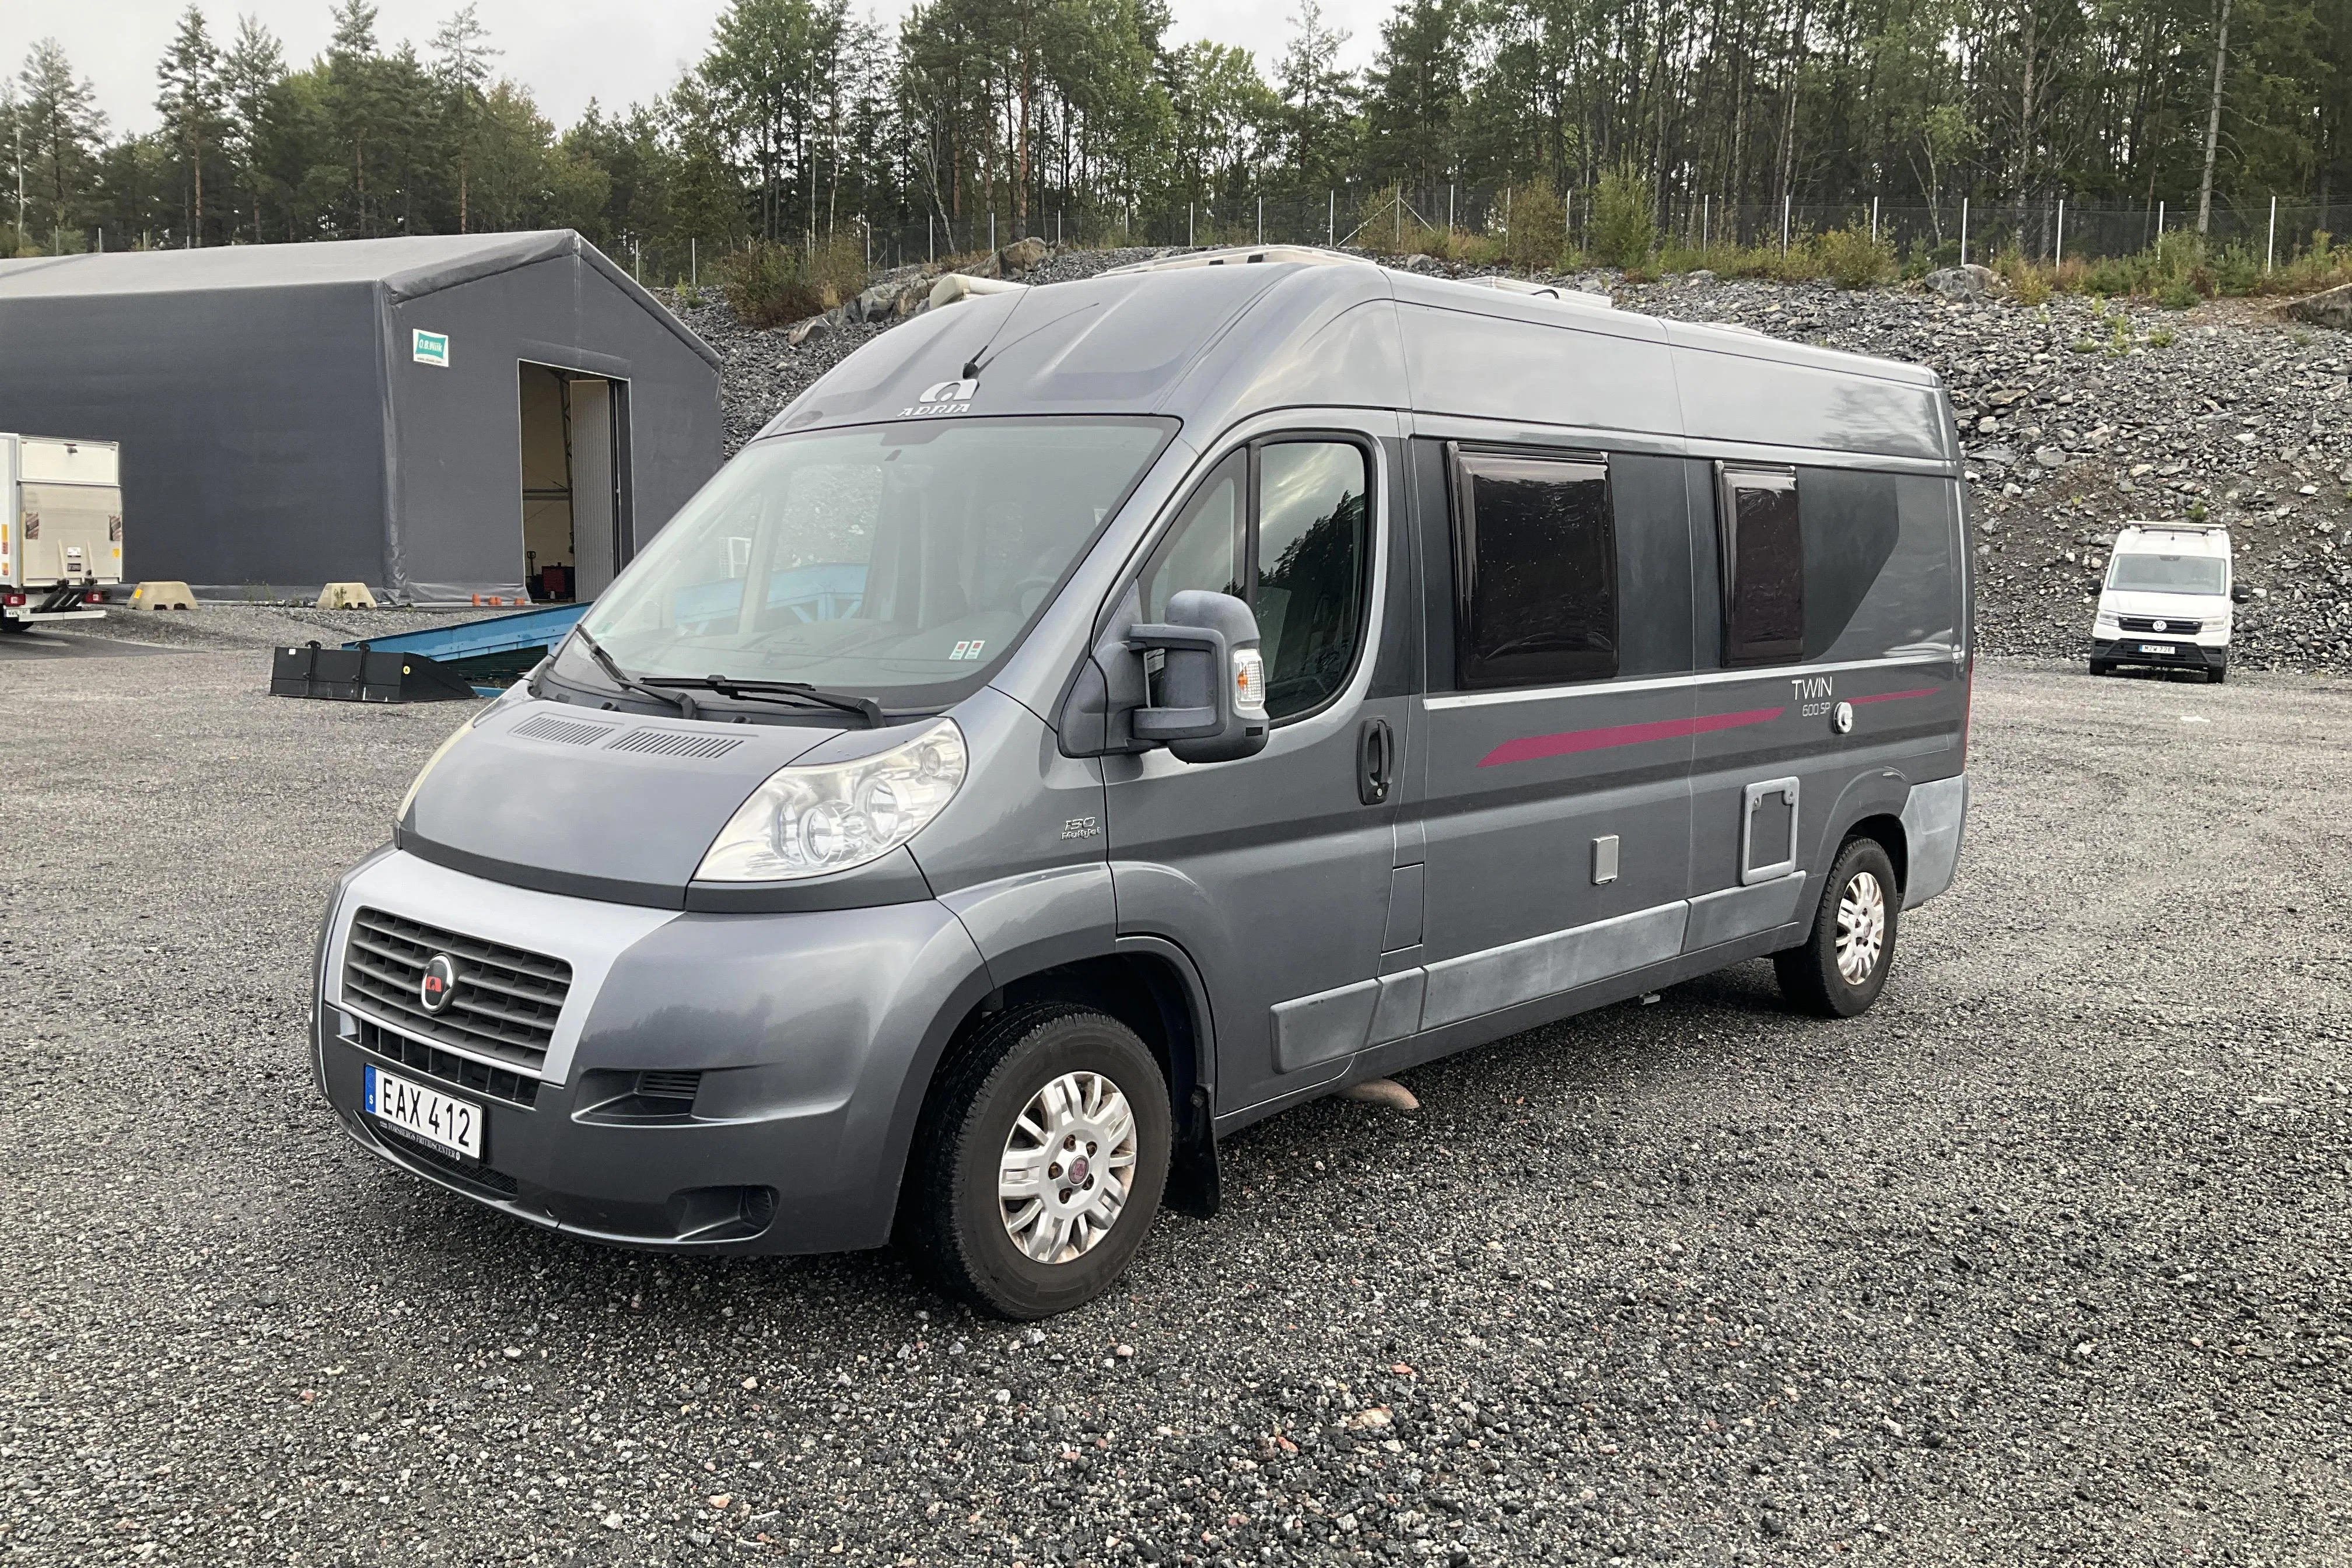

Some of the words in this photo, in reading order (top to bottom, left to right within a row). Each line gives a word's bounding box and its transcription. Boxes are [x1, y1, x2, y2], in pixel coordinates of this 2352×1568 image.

[897, 404, 971, 418] ADRIA
[1791, 676, 1832, 701] TWIN
[1802, 703, 1819, 717] 600
[1820, 702, 1831, 715] SP
[1065, 817, 1096, 831] 150
[369, 1094, 373, 1105] S
[383, 1077, 421, 1128] EAX
[428, 1097, 470, 1147] 412
[388, 1122, 416, 1141] FORSBERGS
